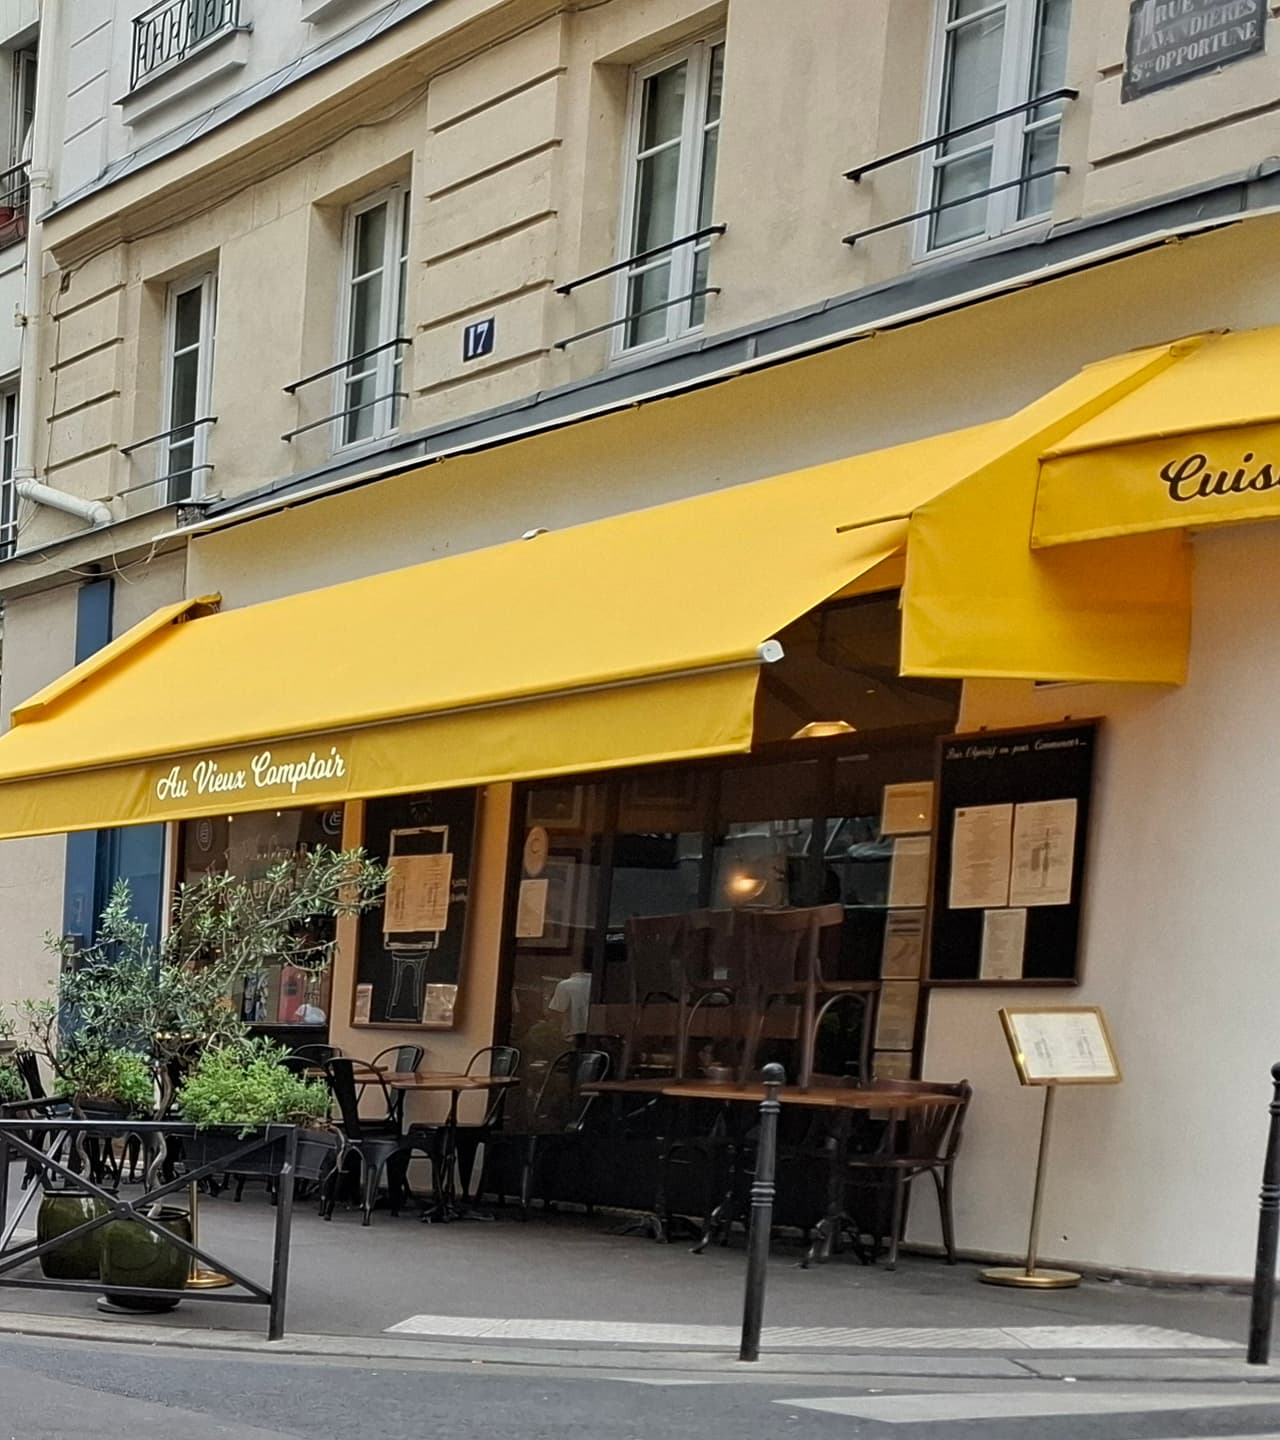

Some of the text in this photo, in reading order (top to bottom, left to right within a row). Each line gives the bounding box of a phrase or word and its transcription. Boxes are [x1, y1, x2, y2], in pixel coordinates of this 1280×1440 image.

[467, 321, 490, 358] 17
[1159, 452, 1280, 502] Cuis
[156, 746, 346, 800] Au Vieux Comptoir
